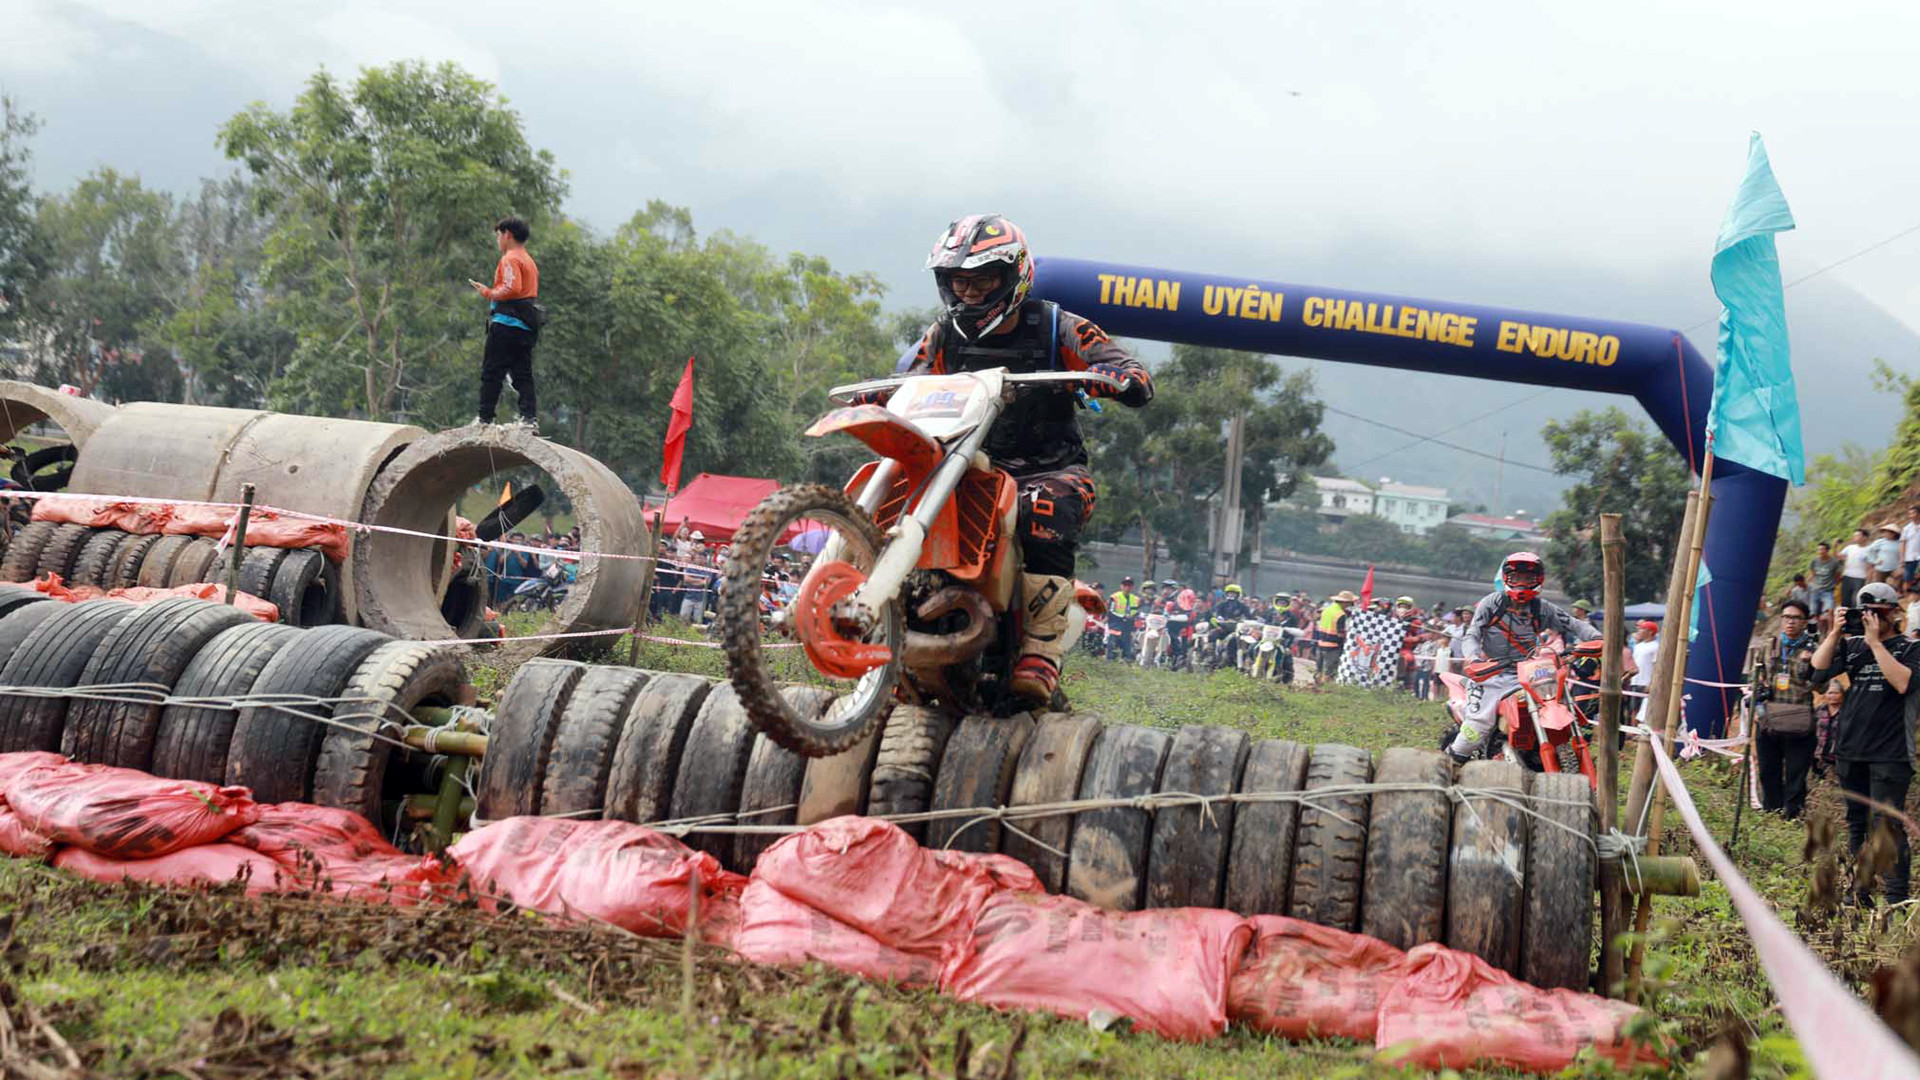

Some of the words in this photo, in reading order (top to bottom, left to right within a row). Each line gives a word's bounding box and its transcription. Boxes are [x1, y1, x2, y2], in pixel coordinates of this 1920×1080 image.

[1098, 274, 1181, 311] THAN
[1203, 284, 1284, 322] UYÊN
[1302, 296, 1478, 347] CHALLENGE
[1496, 320, 1620, 367] ENDURO
